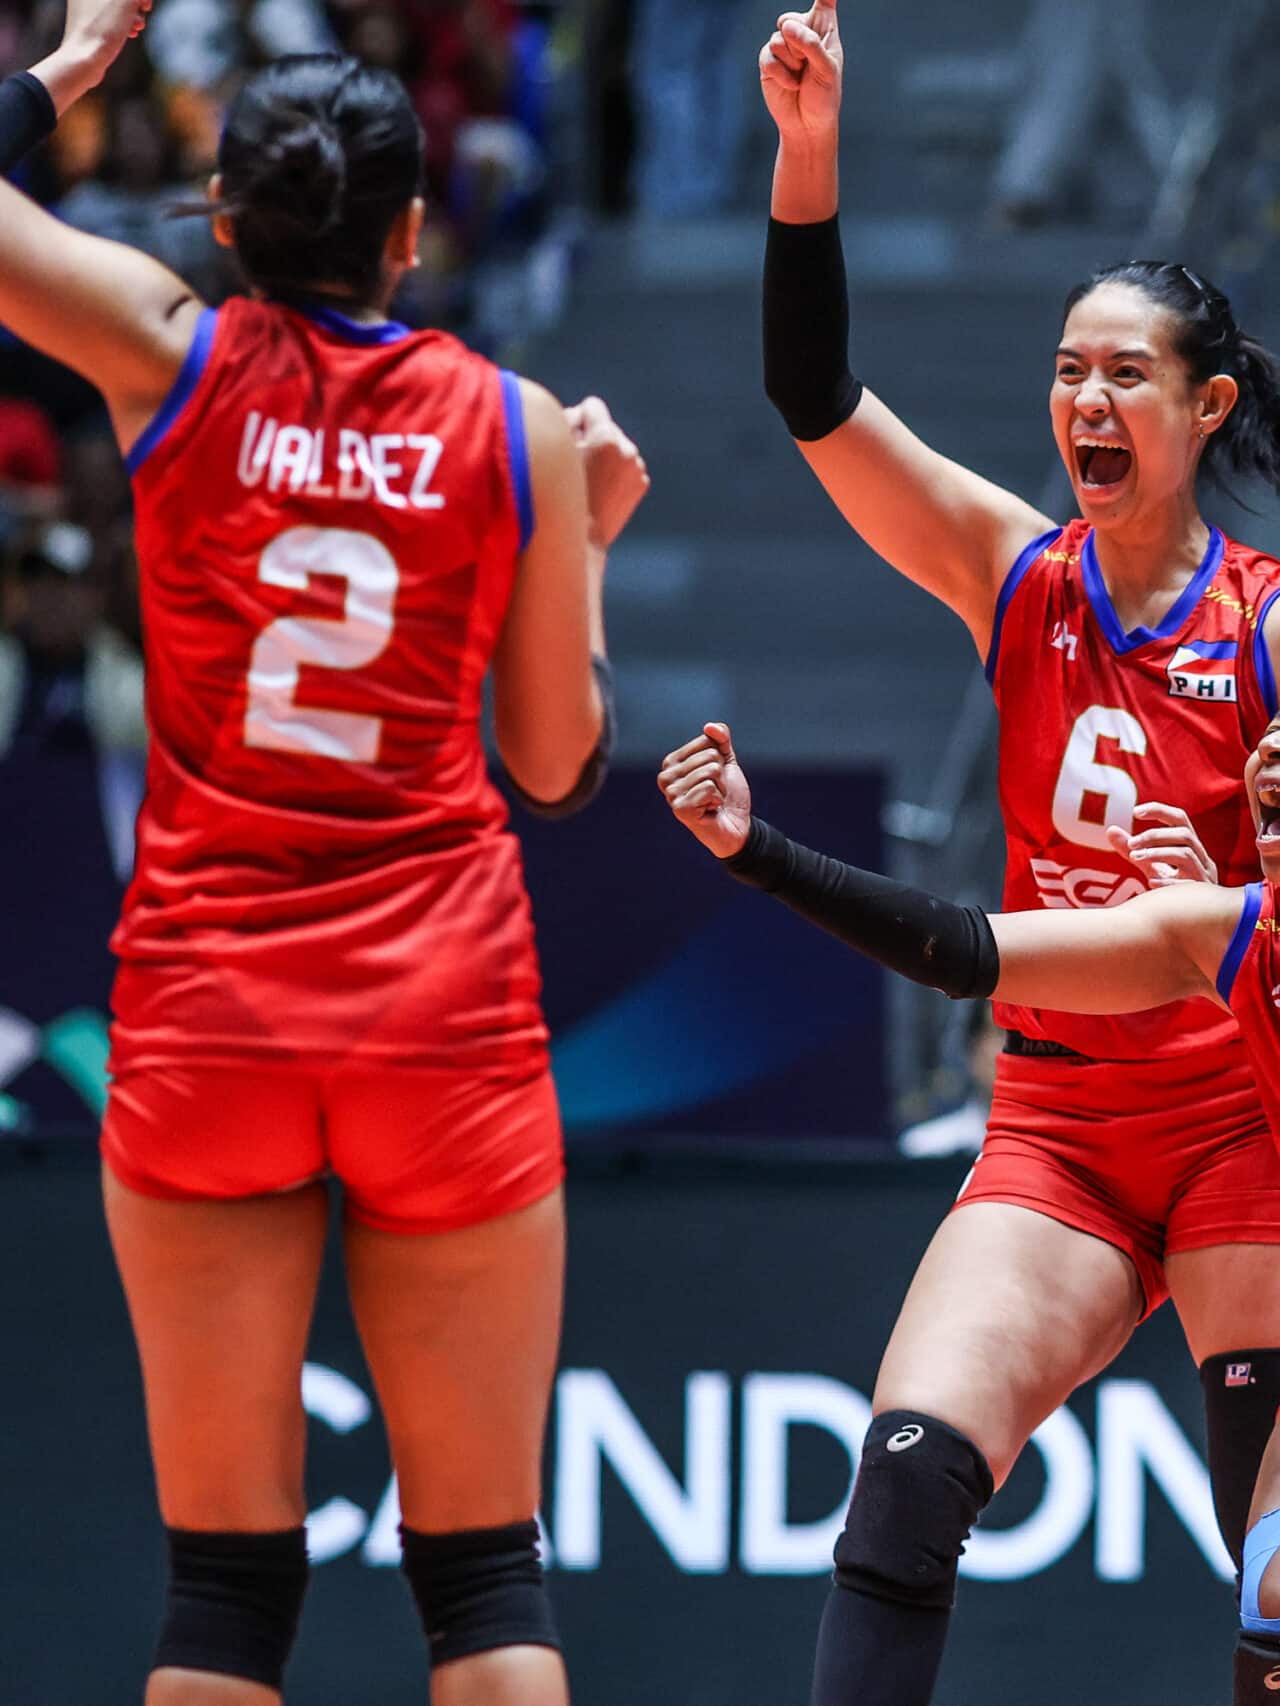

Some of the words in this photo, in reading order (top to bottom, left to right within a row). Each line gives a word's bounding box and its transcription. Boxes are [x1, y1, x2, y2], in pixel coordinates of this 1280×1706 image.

[237, 410, 445, 509] VALDEZ
[244, 525, 399, 763] 2
[1174, 676, 1231, 697] PHI
[1051, 704, 1148, 853] 6
[301, 1361, 1238, 1583] NDON
